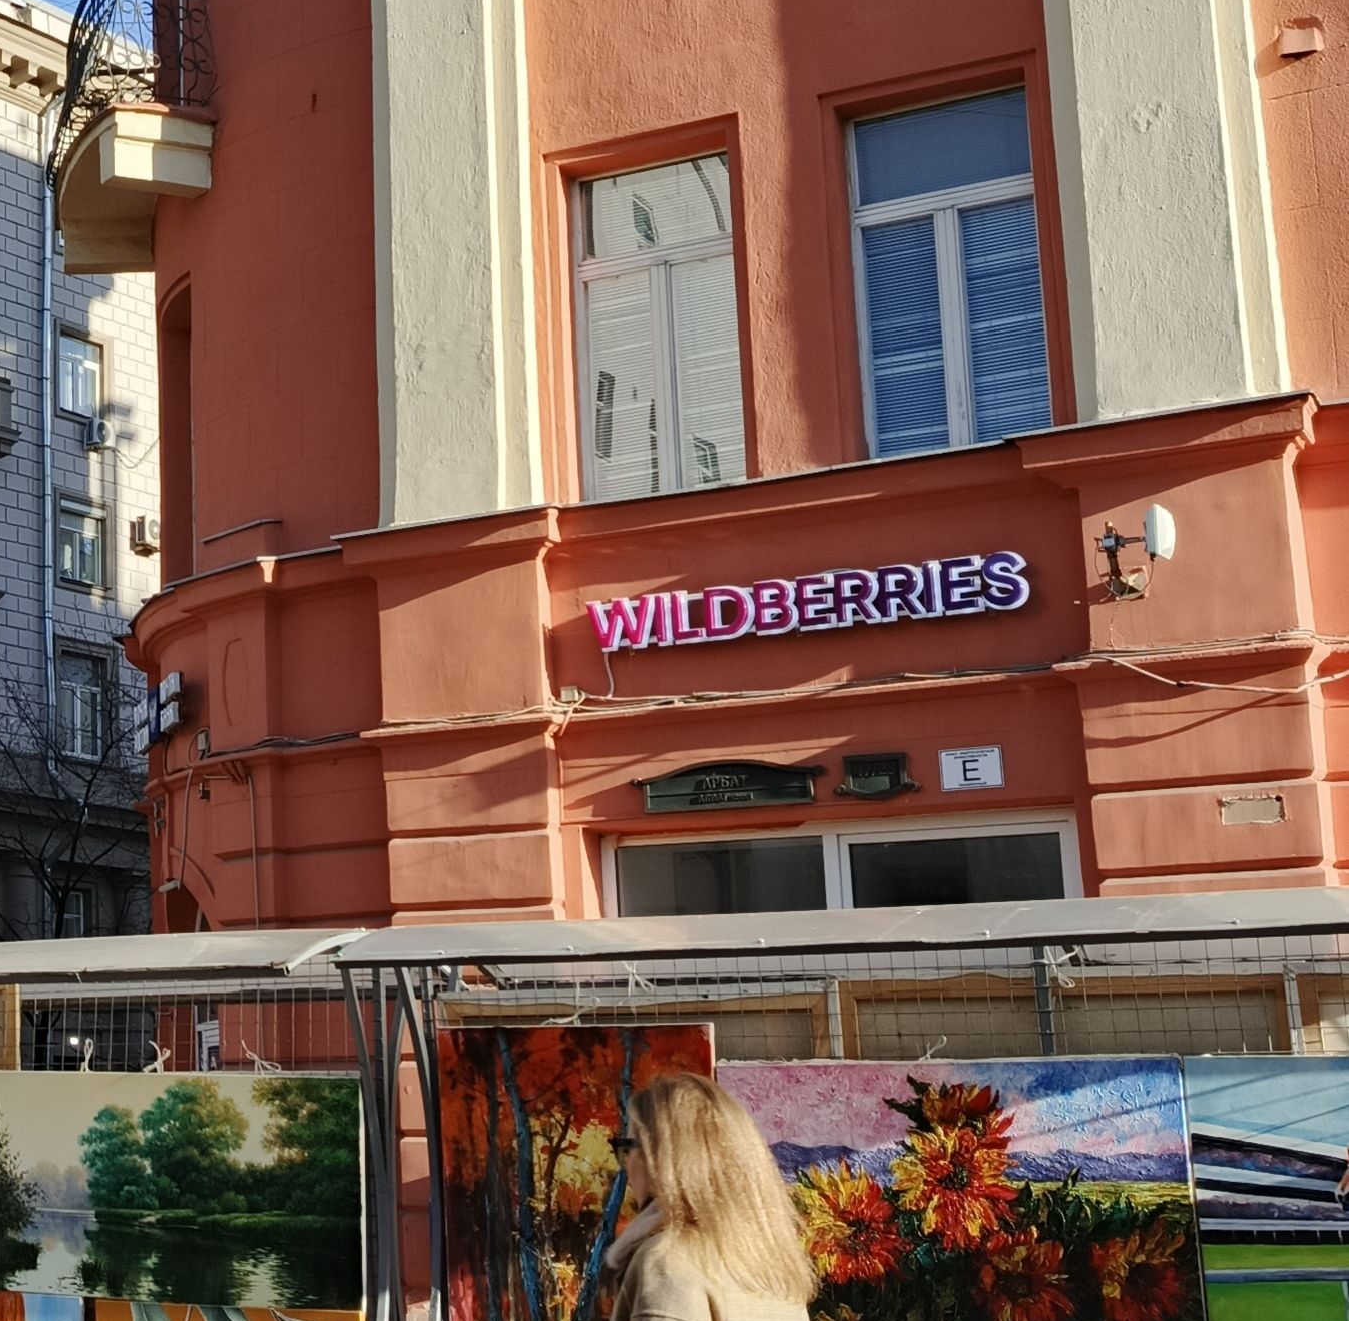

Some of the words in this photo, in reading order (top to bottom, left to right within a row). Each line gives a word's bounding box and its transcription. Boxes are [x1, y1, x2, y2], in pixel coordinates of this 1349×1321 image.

[585, 551, 1029, 652] WILDBERRIES
[962, 759, 981, 781] E
[702, 774, 748, 790] АРБАТ
